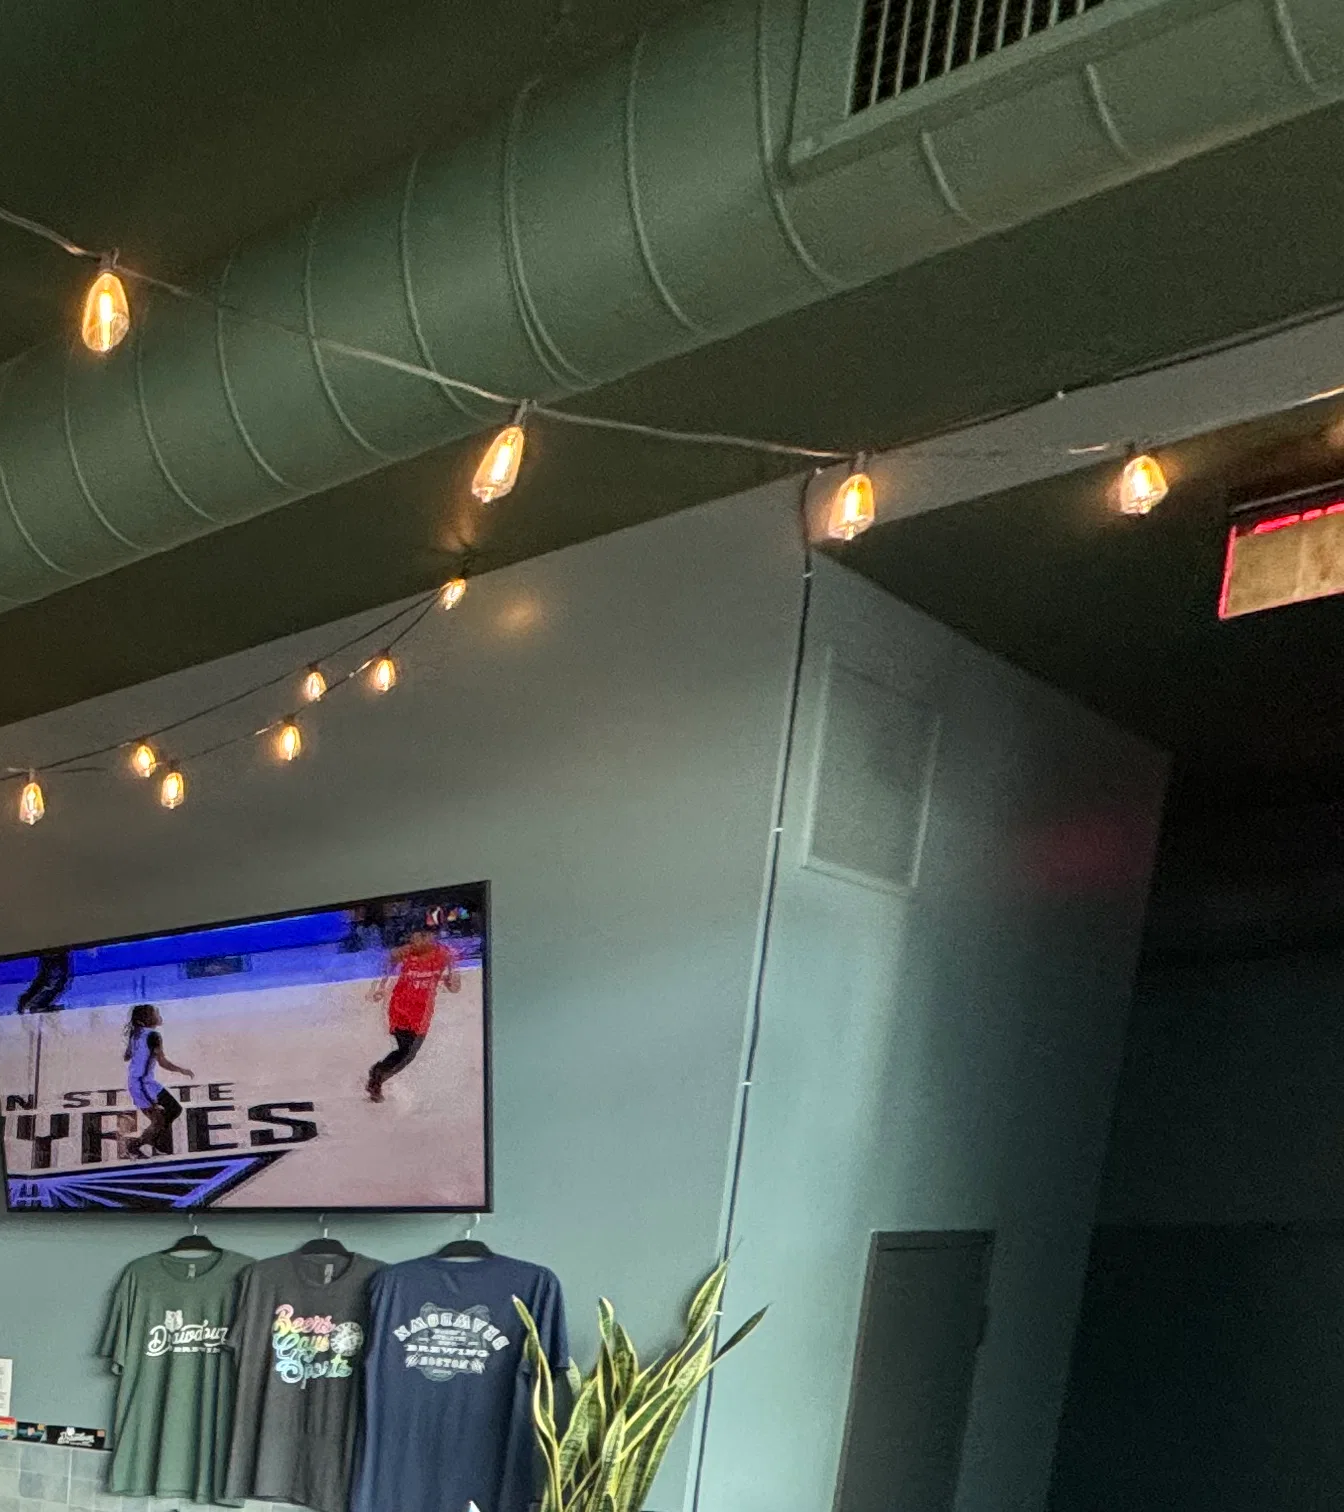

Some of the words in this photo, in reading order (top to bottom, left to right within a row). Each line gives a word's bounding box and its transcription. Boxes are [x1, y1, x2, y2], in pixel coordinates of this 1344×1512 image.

[63, 1082, 235, 1109] STTE
[17, 1101, 319, 1168] YRES
[404, 1344, 490, 1358] BREWING
